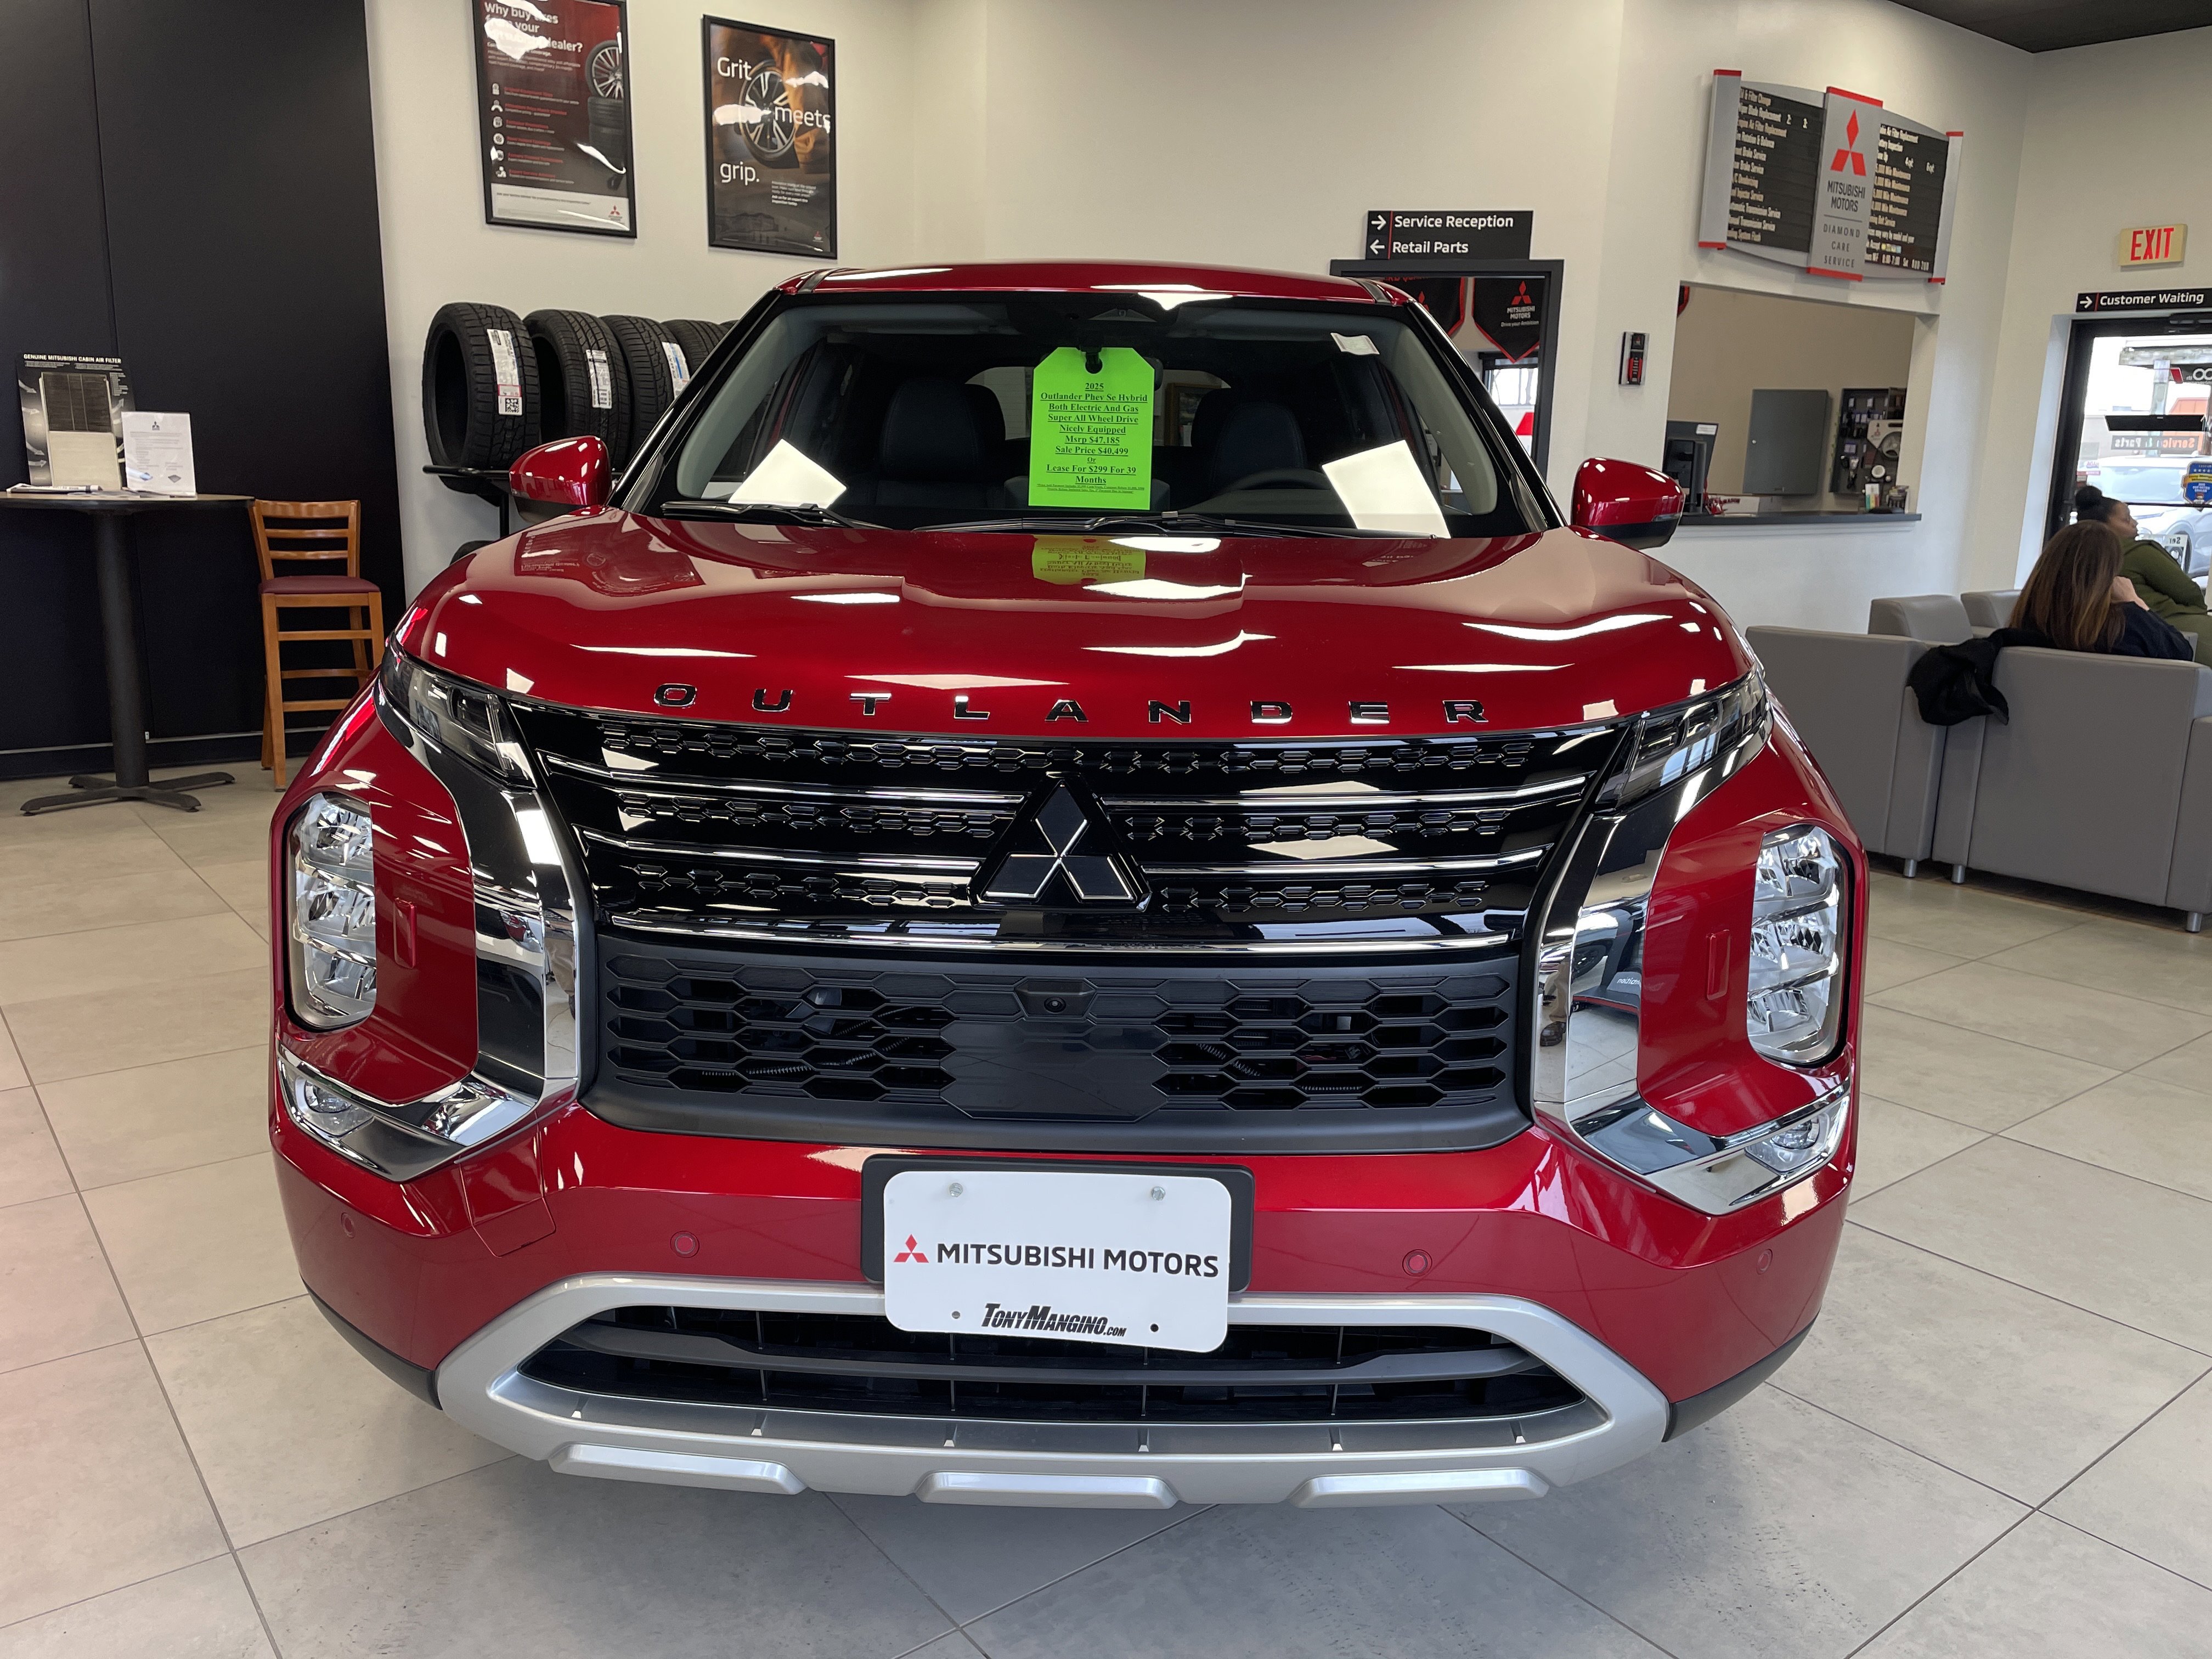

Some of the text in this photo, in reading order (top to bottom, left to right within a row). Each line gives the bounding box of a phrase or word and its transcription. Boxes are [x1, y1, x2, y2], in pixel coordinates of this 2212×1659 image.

[484, 2, 509, 18] Why
[511, 7, 532, 21] buy
[716, 57, 752, 81] Grit
[774, 105, 831, 129] meets
[719, 161, 760, 186] grip.
[1827, 180, 1866, 199] MITSUBISHI
[1830, 196, 1859, 213] MOTORS
[1394, 215, 1514, 230] Service Reception
[1823, 223, 1860, 238] DIAMOND
[1392, 241, 1469, 253] Retail Parts
[1831, 241, 1850, 252] CARE
[2130, 227, 2174, 261] EXIT
[1824, 255, 1855, 268] SERVICE
[2100, 292, 2204, 306] Customer Waiting
[1040, 392, 1083, 400] Outlander
[1106, 393, 1116, 402] Se
[1118, 394, 1148, 403] Hybrid
[1070, 403, 1101, 411] Electric
[1048, 414, 1072, 422] Super
[1059, 424, 1126, 434] Nicely Equipped
[1065, 436, 1087, 444] Msrp
[1075, 446, 1096, 454] Price
[654, 682, 1489, 724] OUTLANDER
[937, 1243, 1219, 1278] MITSUBISHI MOTORS
[981, 1303, 1127, 1336] TONYMANGINO.COM
